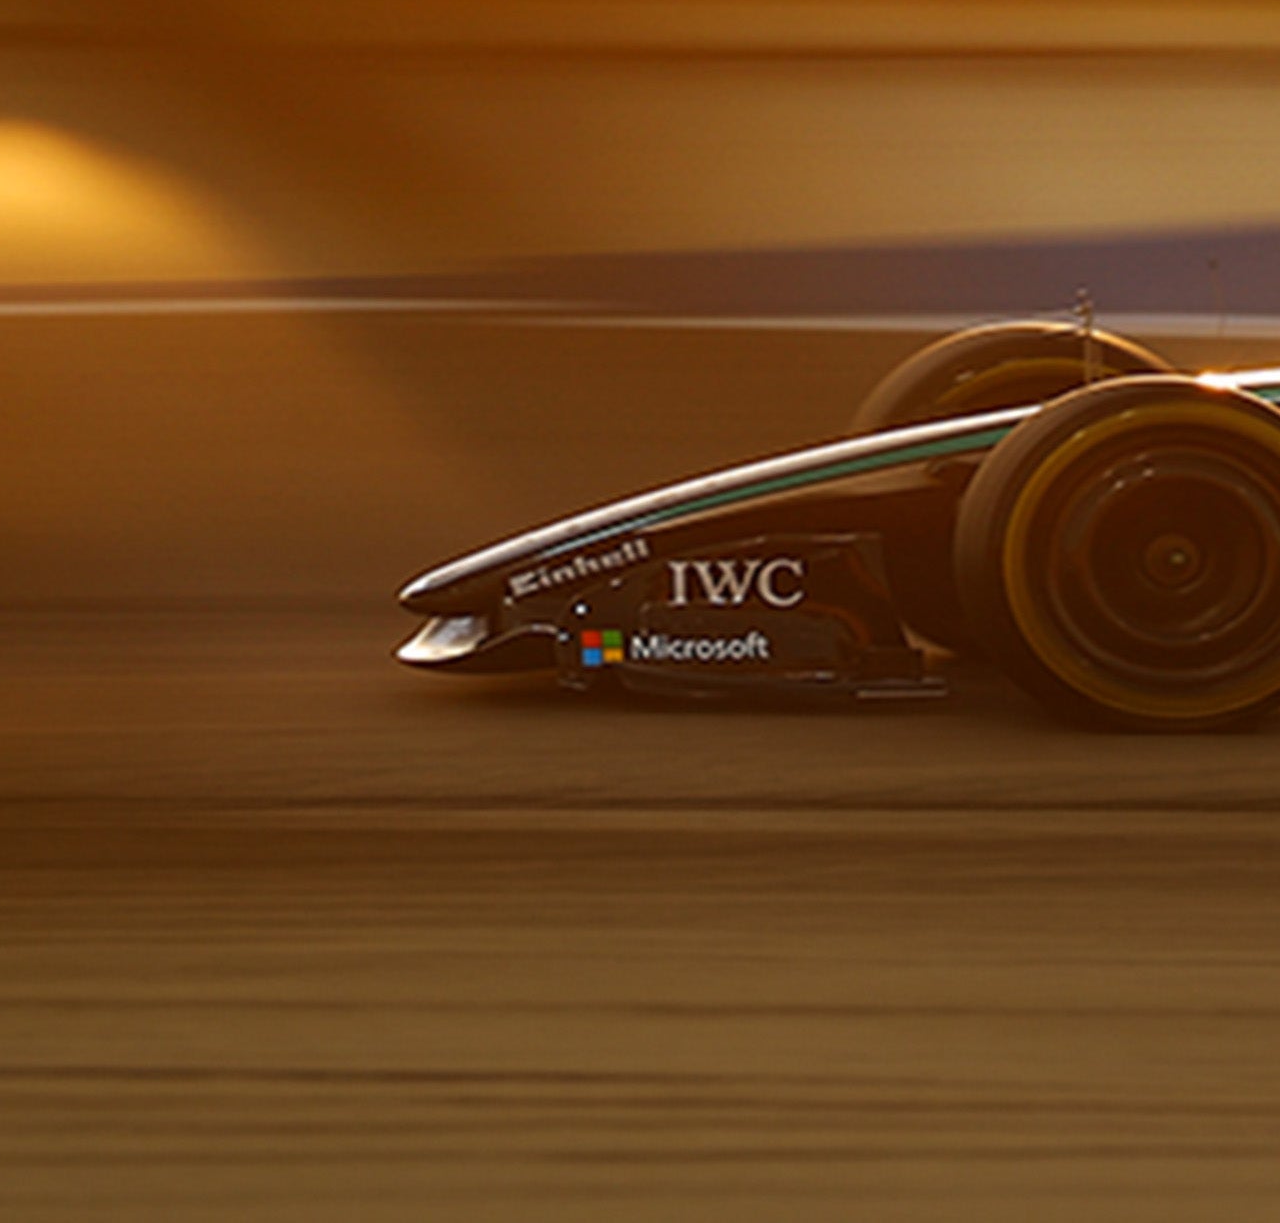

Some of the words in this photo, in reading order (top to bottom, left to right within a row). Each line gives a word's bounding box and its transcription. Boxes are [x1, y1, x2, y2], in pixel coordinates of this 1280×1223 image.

[508, 538, 650, 598] Einhell
[668, 559, 804, 607] IWC
[630, 631, 770, 660] Microsoft
